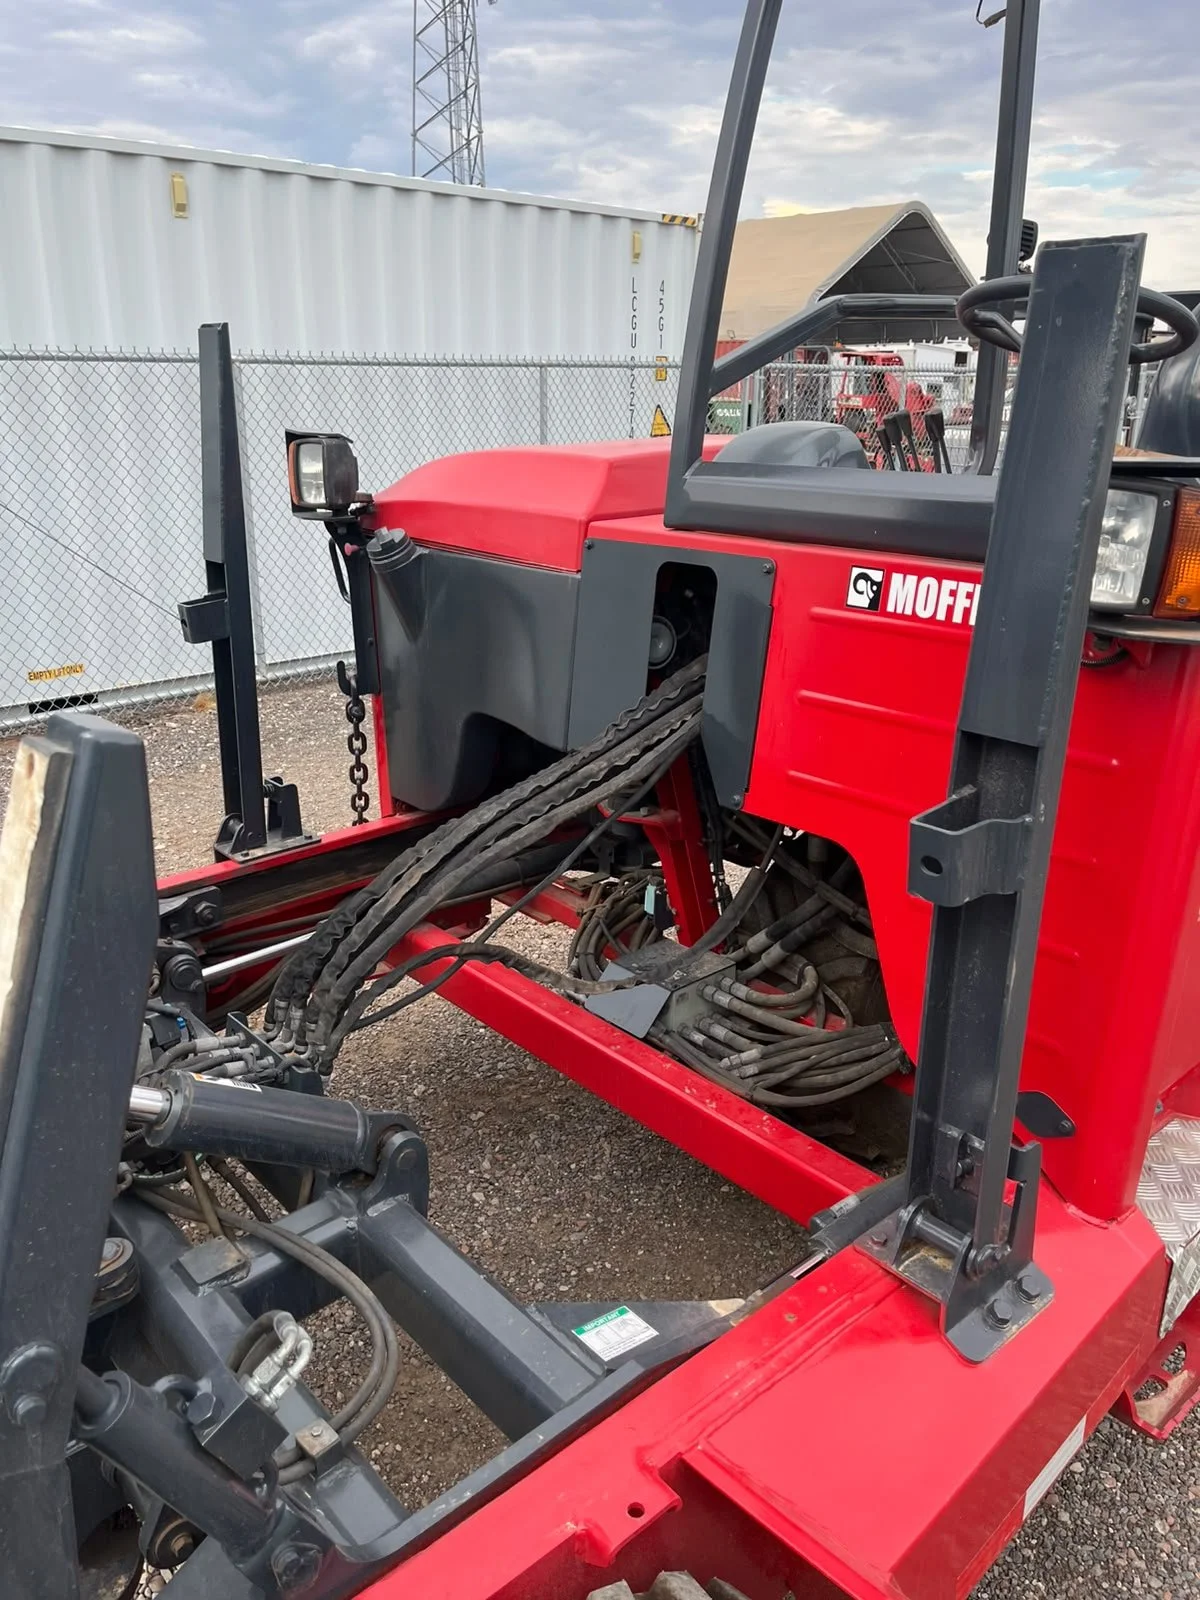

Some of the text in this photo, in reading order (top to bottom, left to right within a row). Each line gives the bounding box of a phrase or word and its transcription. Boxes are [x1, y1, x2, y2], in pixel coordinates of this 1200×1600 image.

[630, 276, 638, 349] LCGU
[28, 663, 84, 681] EMPTY LIFT ONLY
[583, 1311, 620, 1331] IMPORTANT
